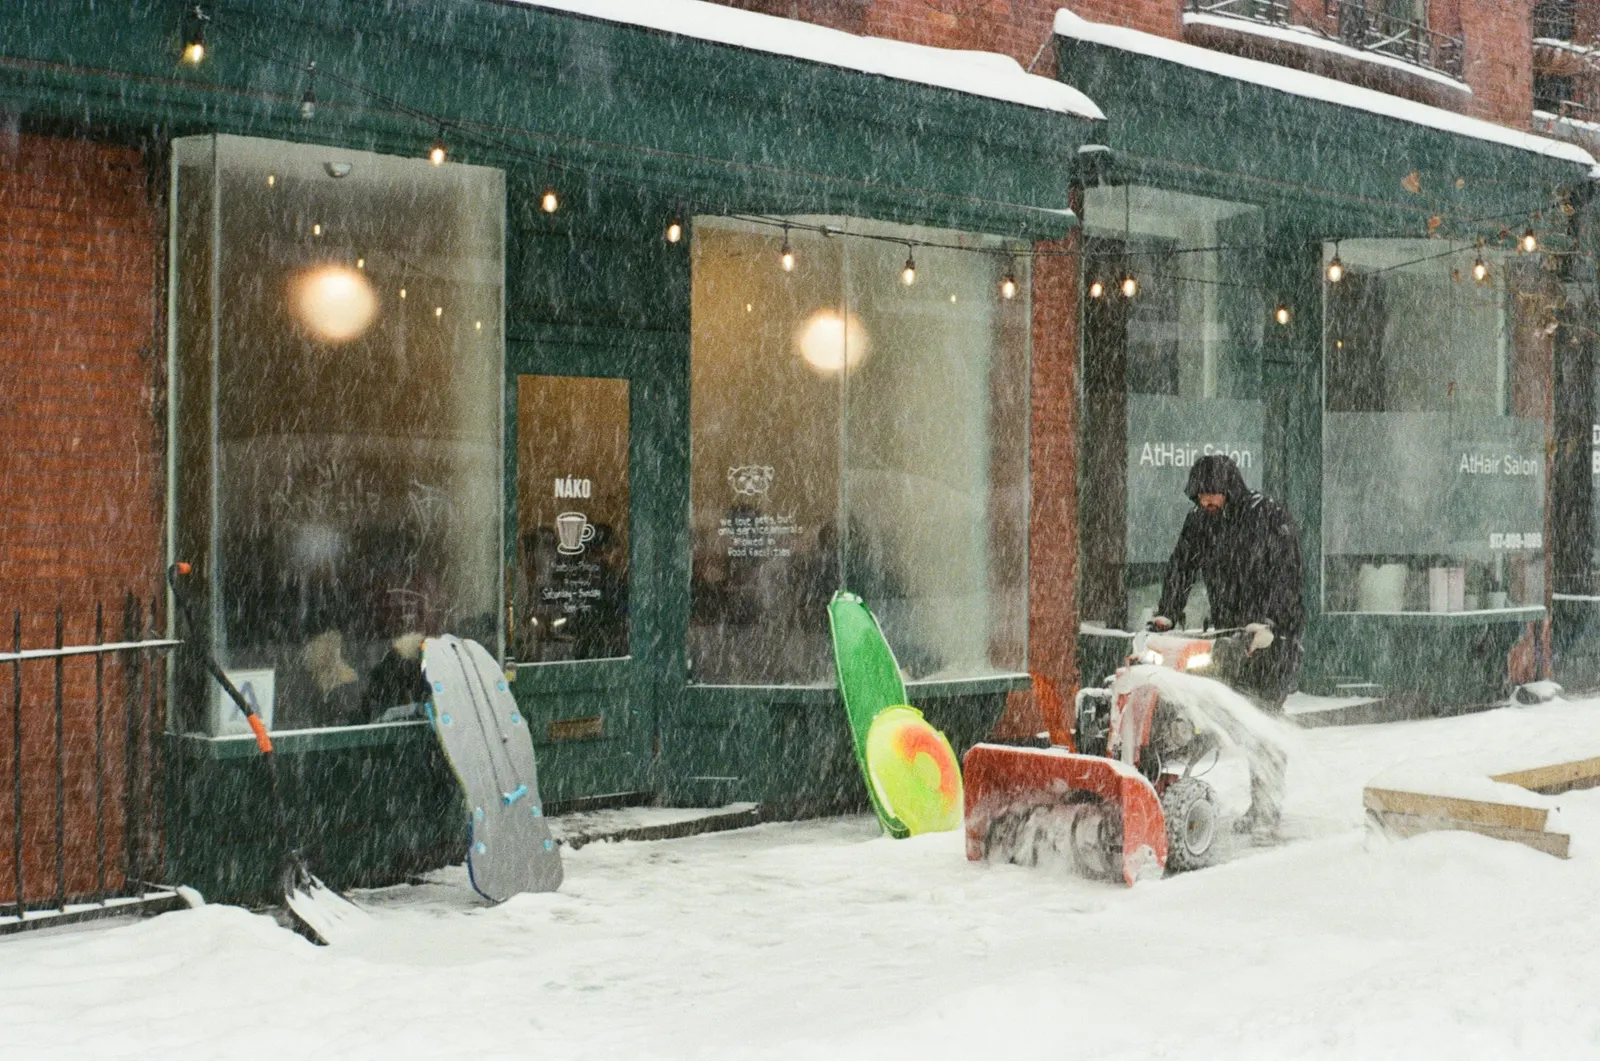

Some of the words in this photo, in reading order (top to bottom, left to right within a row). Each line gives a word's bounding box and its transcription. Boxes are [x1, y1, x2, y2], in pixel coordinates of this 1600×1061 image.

[1140, 442, 1198, 467] AtHair
[1460, 453, 1500, 474] AtHair
[1504, 454, 1538, 475] Salon
[555, 473, 591, 498] NÁKO
